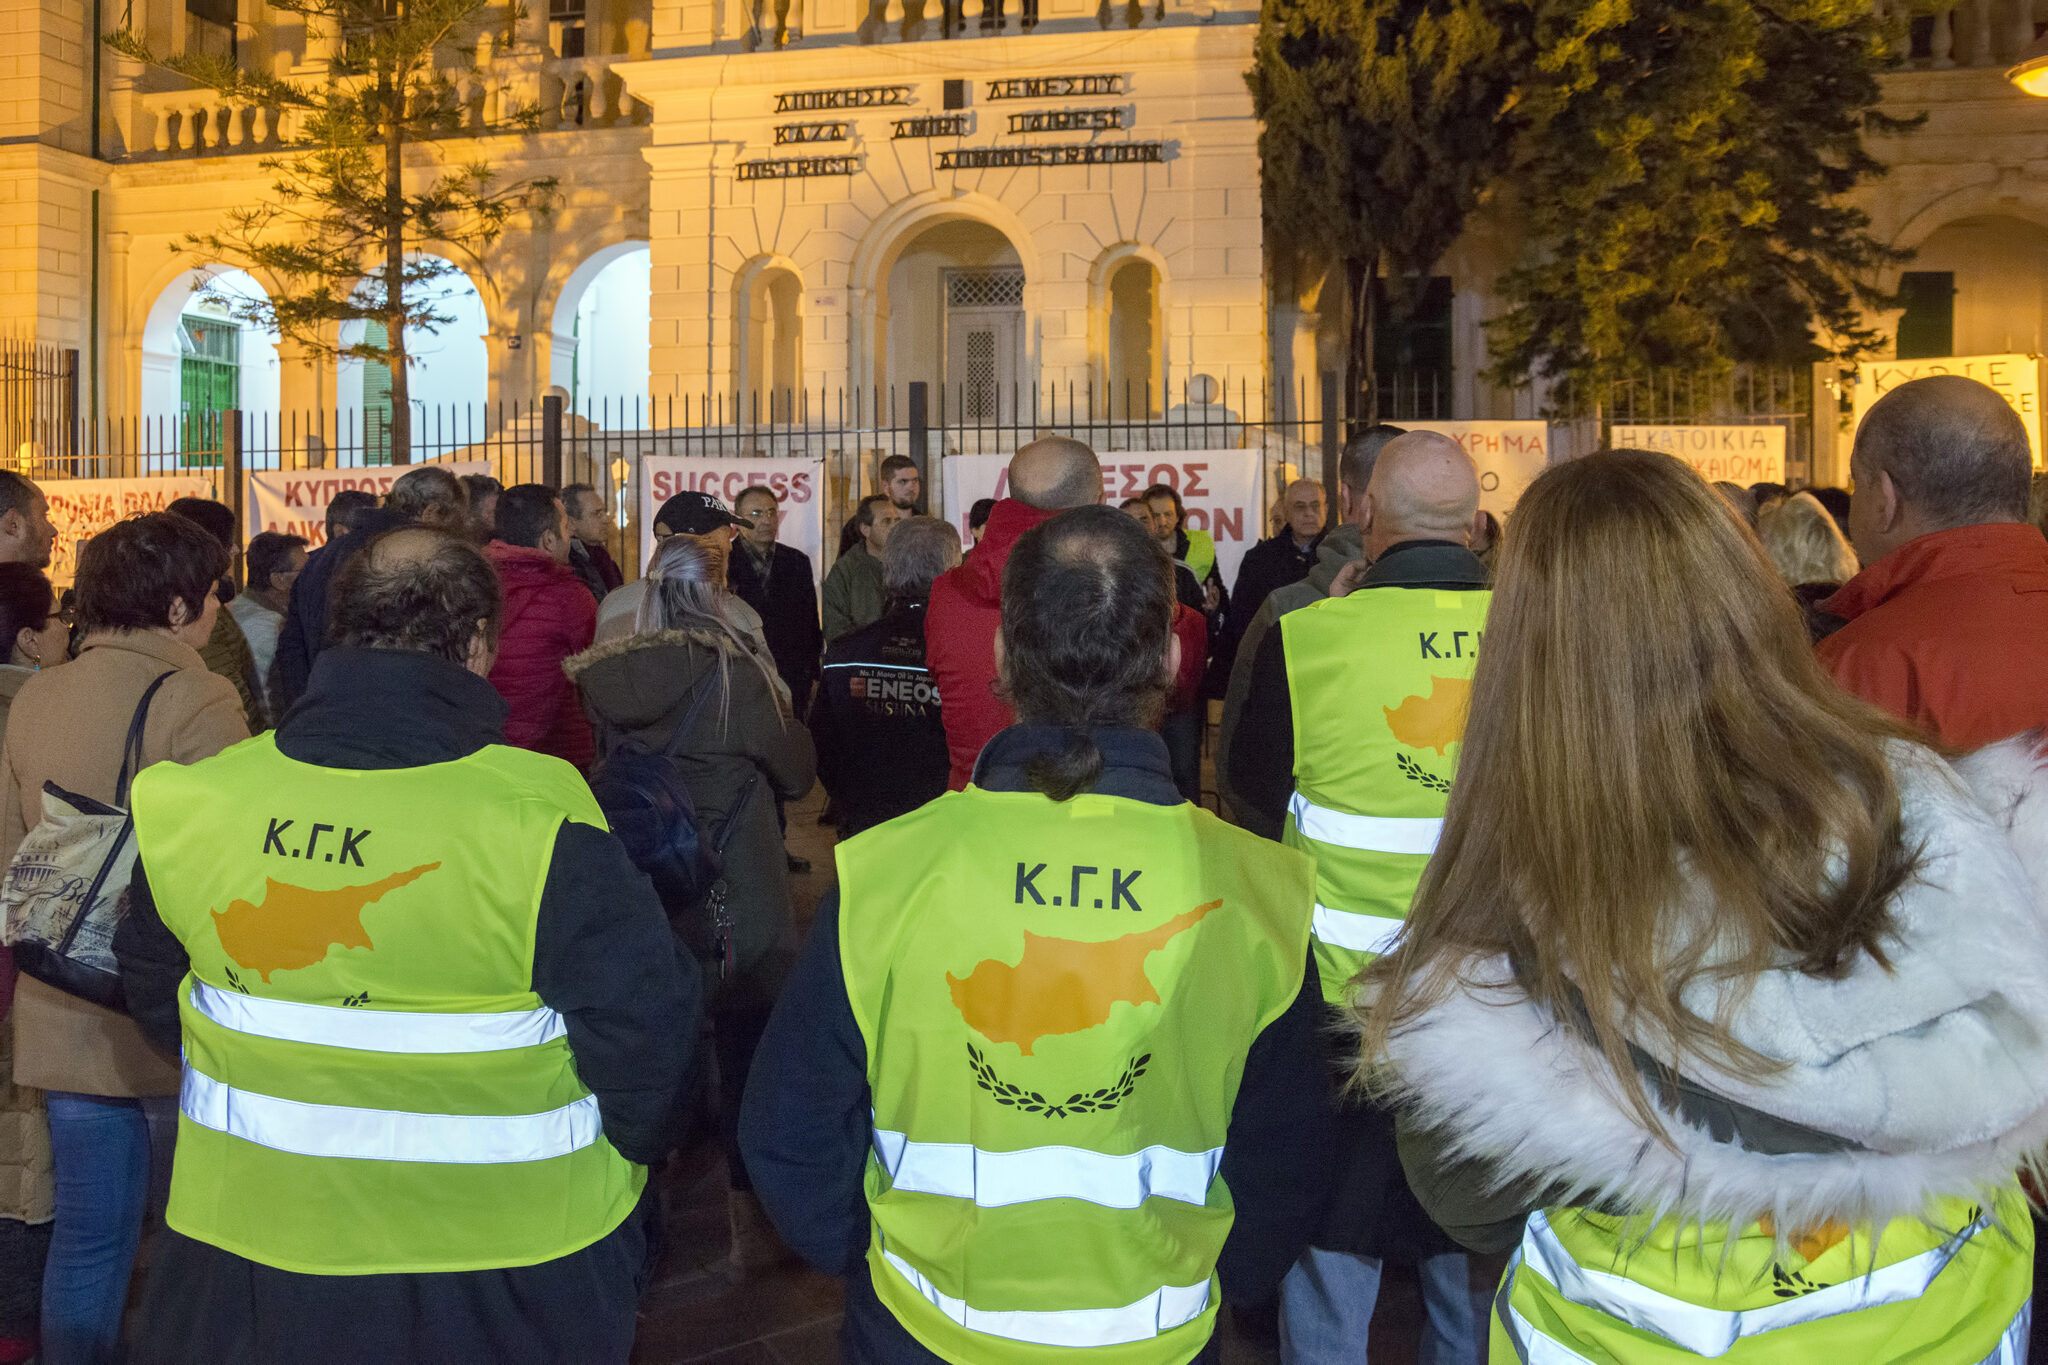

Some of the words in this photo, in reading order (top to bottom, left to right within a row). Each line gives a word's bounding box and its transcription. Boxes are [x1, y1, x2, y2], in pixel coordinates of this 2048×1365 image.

[774, 122, 849, 146] KAZA
[736, 156, 858, 181] DISTRICT
[935, 144, 1162, 170] ADMINISTRATION
[1648, 429, 1767, 450] ΚΑΤΟΙΚΙΑ
[1419, 631, 1482, 659] Κ.Γ.
[262, 817, 372, 867] Κ.Γ.Κ
[1014, 862, 1143, 912] Κ.Γ.Κ
